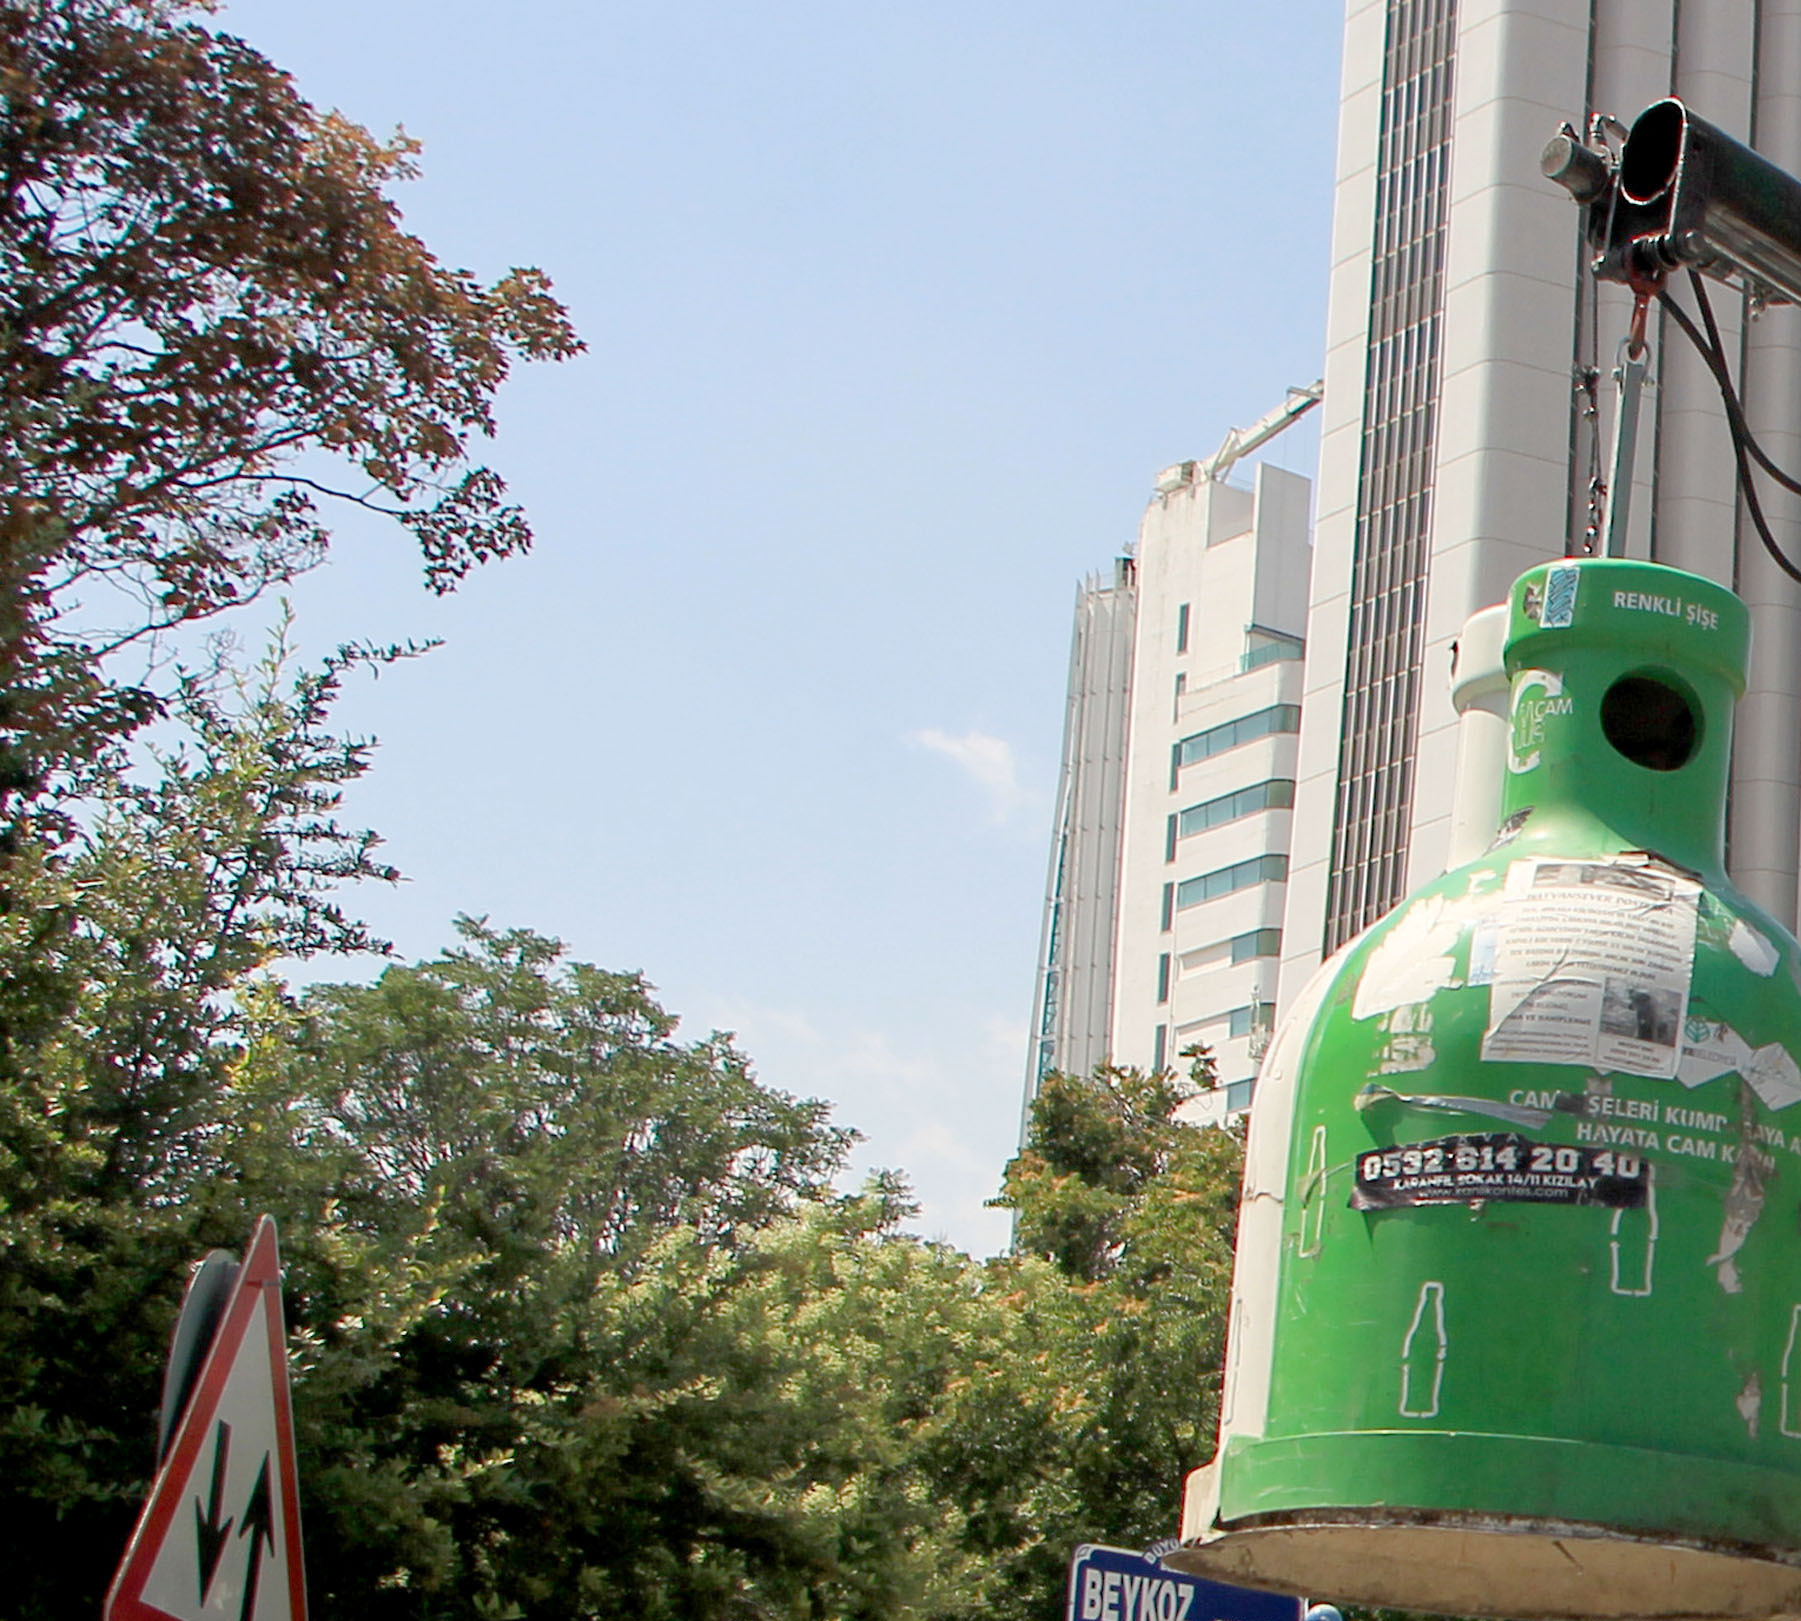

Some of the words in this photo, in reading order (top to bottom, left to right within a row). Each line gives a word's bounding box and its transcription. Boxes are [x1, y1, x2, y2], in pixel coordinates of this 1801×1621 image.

[1614, 591, 1681, 616] RENKLİ
[1686, 603, 1719, 630] ŞİŞE
[1531, 1147, 1579, 1173] 20
[1577, 1122, 1660, 1151] HAYATA
[1666, 1135, 1716, 1160] CAM
